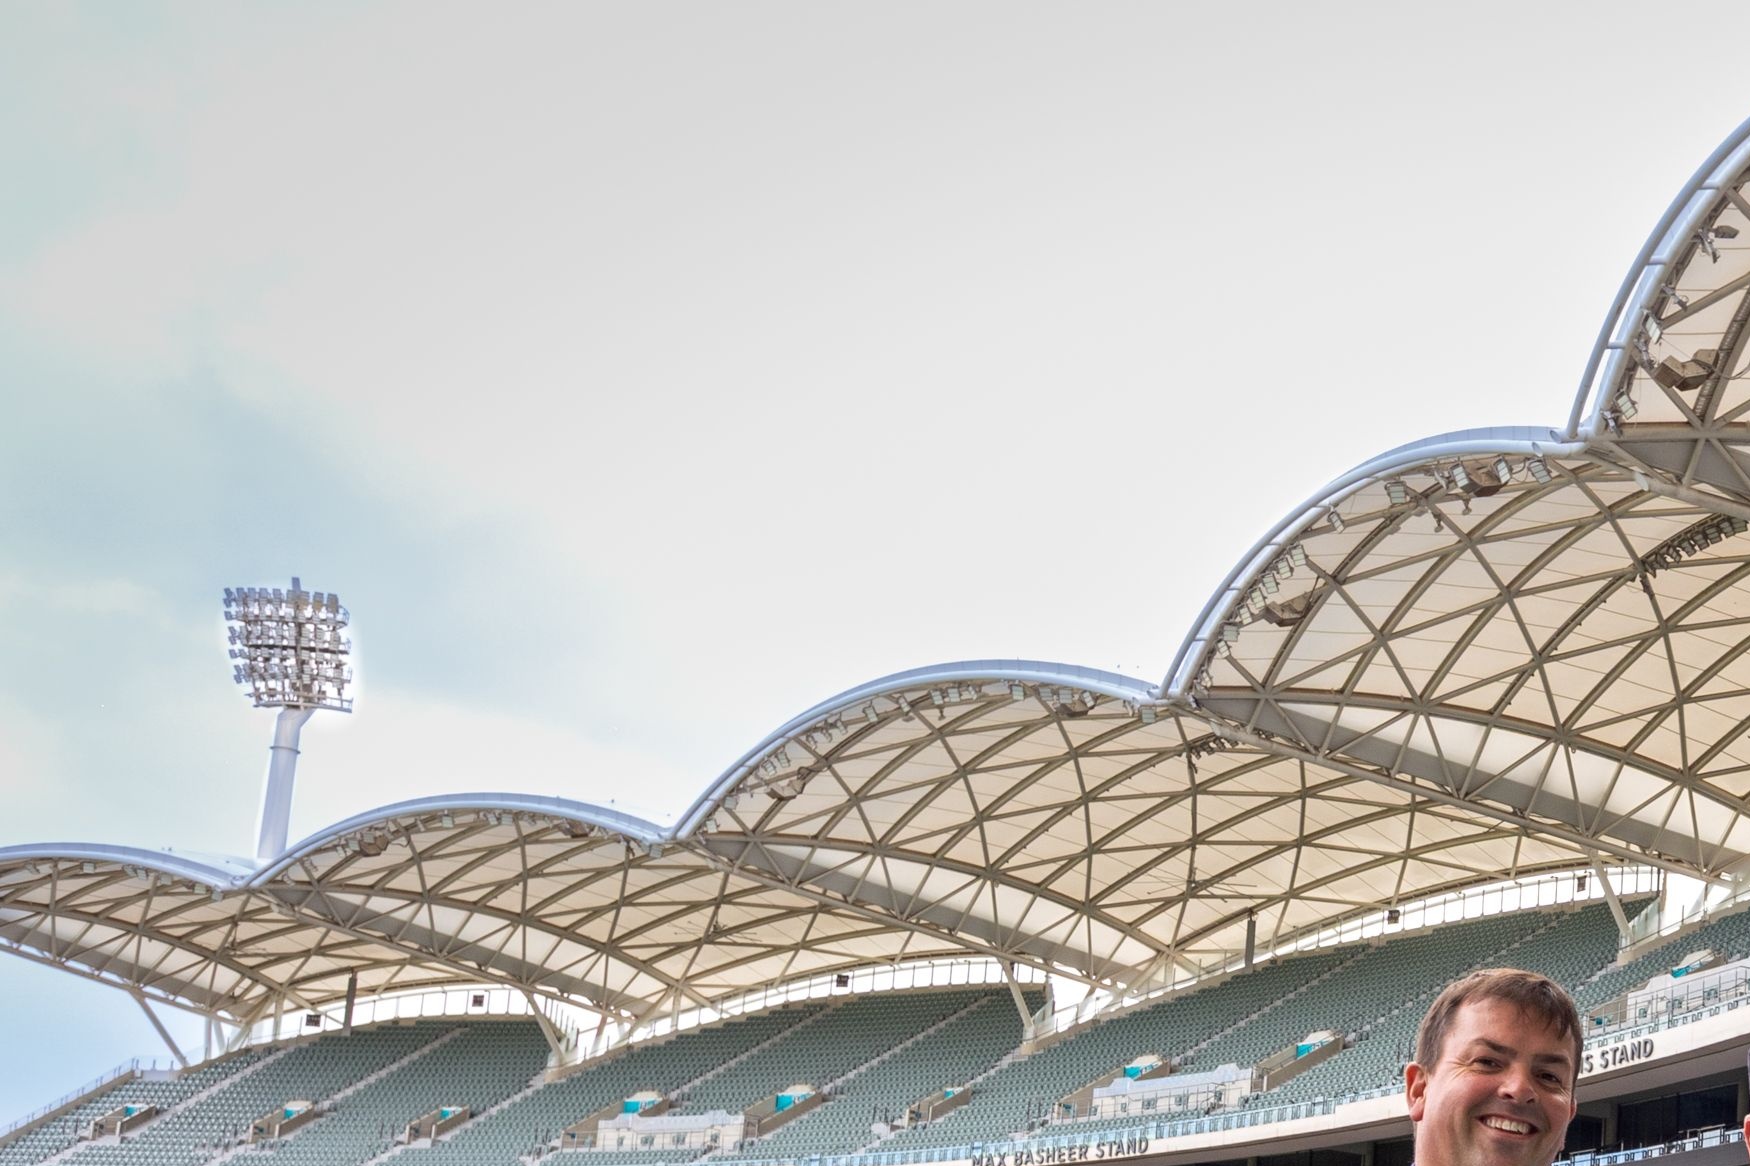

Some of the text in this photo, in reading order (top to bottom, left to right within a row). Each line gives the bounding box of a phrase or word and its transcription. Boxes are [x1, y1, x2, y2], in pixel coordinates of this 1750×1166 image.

[1600, 1038, 1654, 1069] STAND
[1014, 1144, 1089, 1166] BASHEER
[1096, 1136, 1149, 1158] STAND
